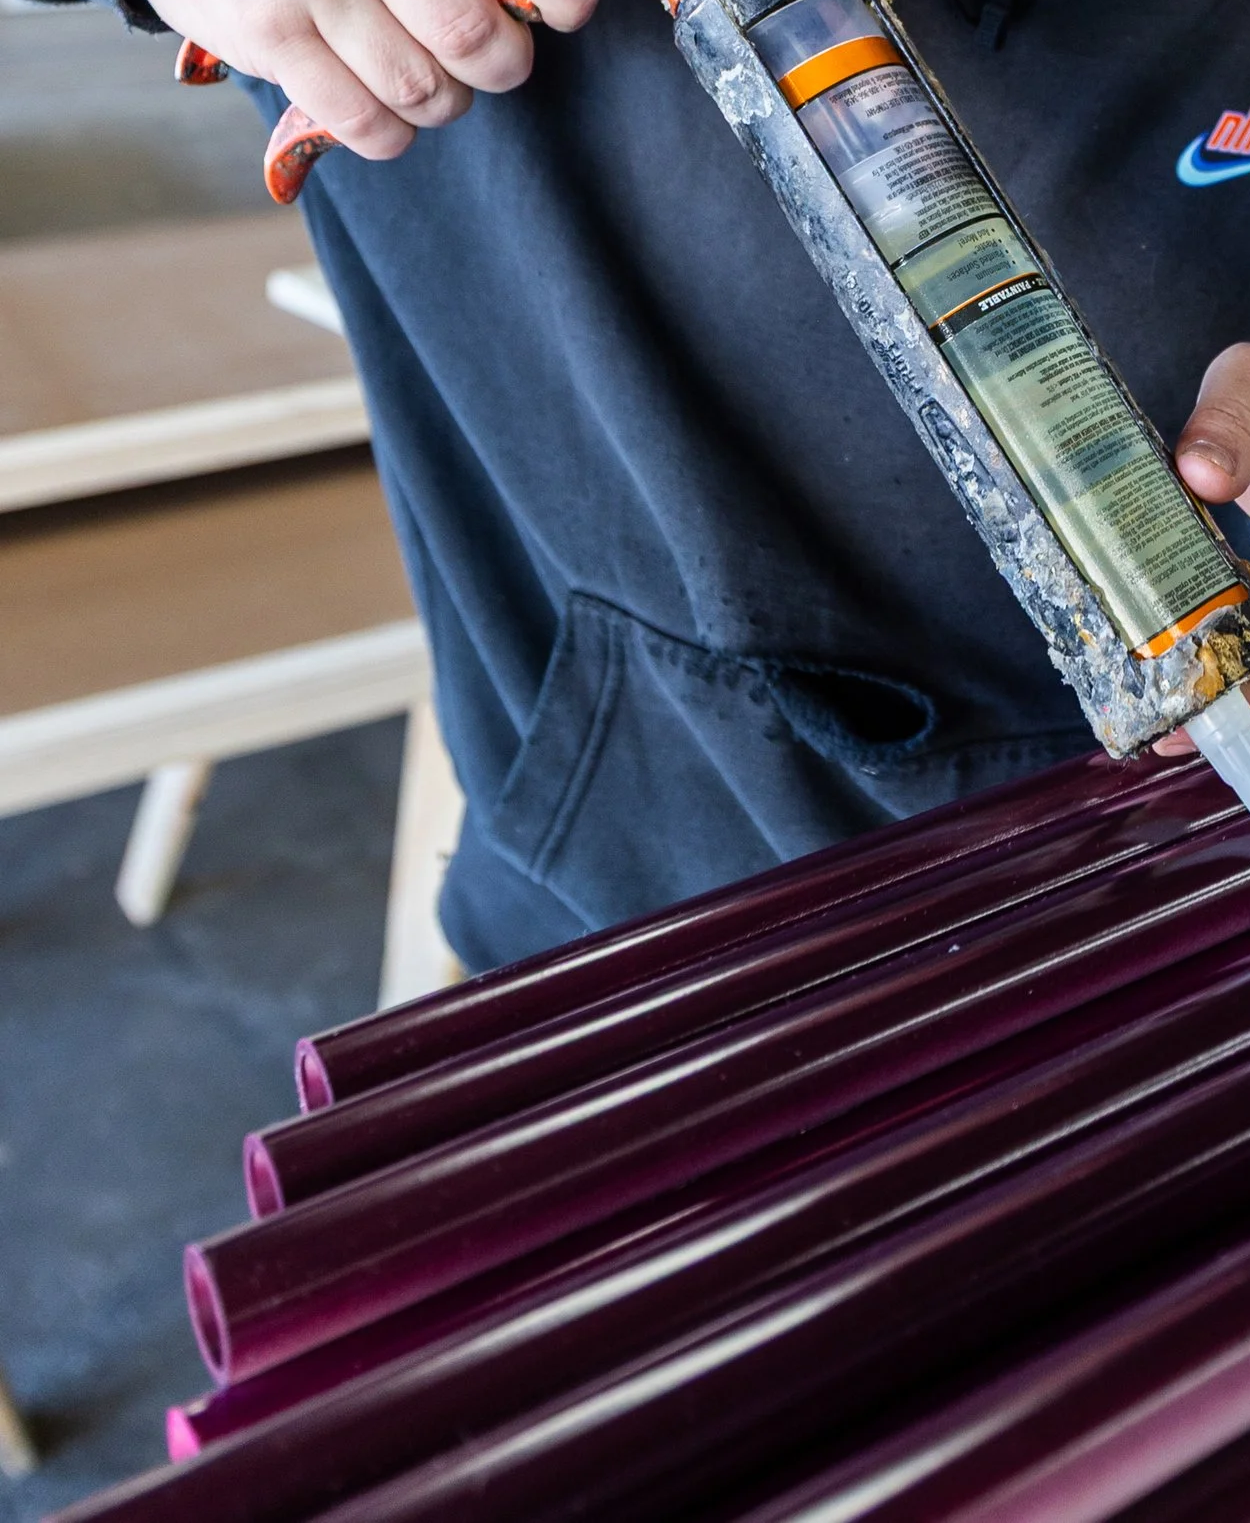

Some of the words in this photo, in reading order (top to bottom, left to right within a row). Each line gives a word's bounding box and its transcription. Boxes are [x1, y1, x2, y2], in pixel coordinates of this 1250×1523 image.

[957, 232, 980, 250] More!
[975, 227, 991, 240] And
[977, 248, 1005, 267] Painted
[945, 260, 979, 283] Surfaces
[976, 260, 1012, 282] Aluminium
[977, 279, 1032, 313] PAINTABLE
